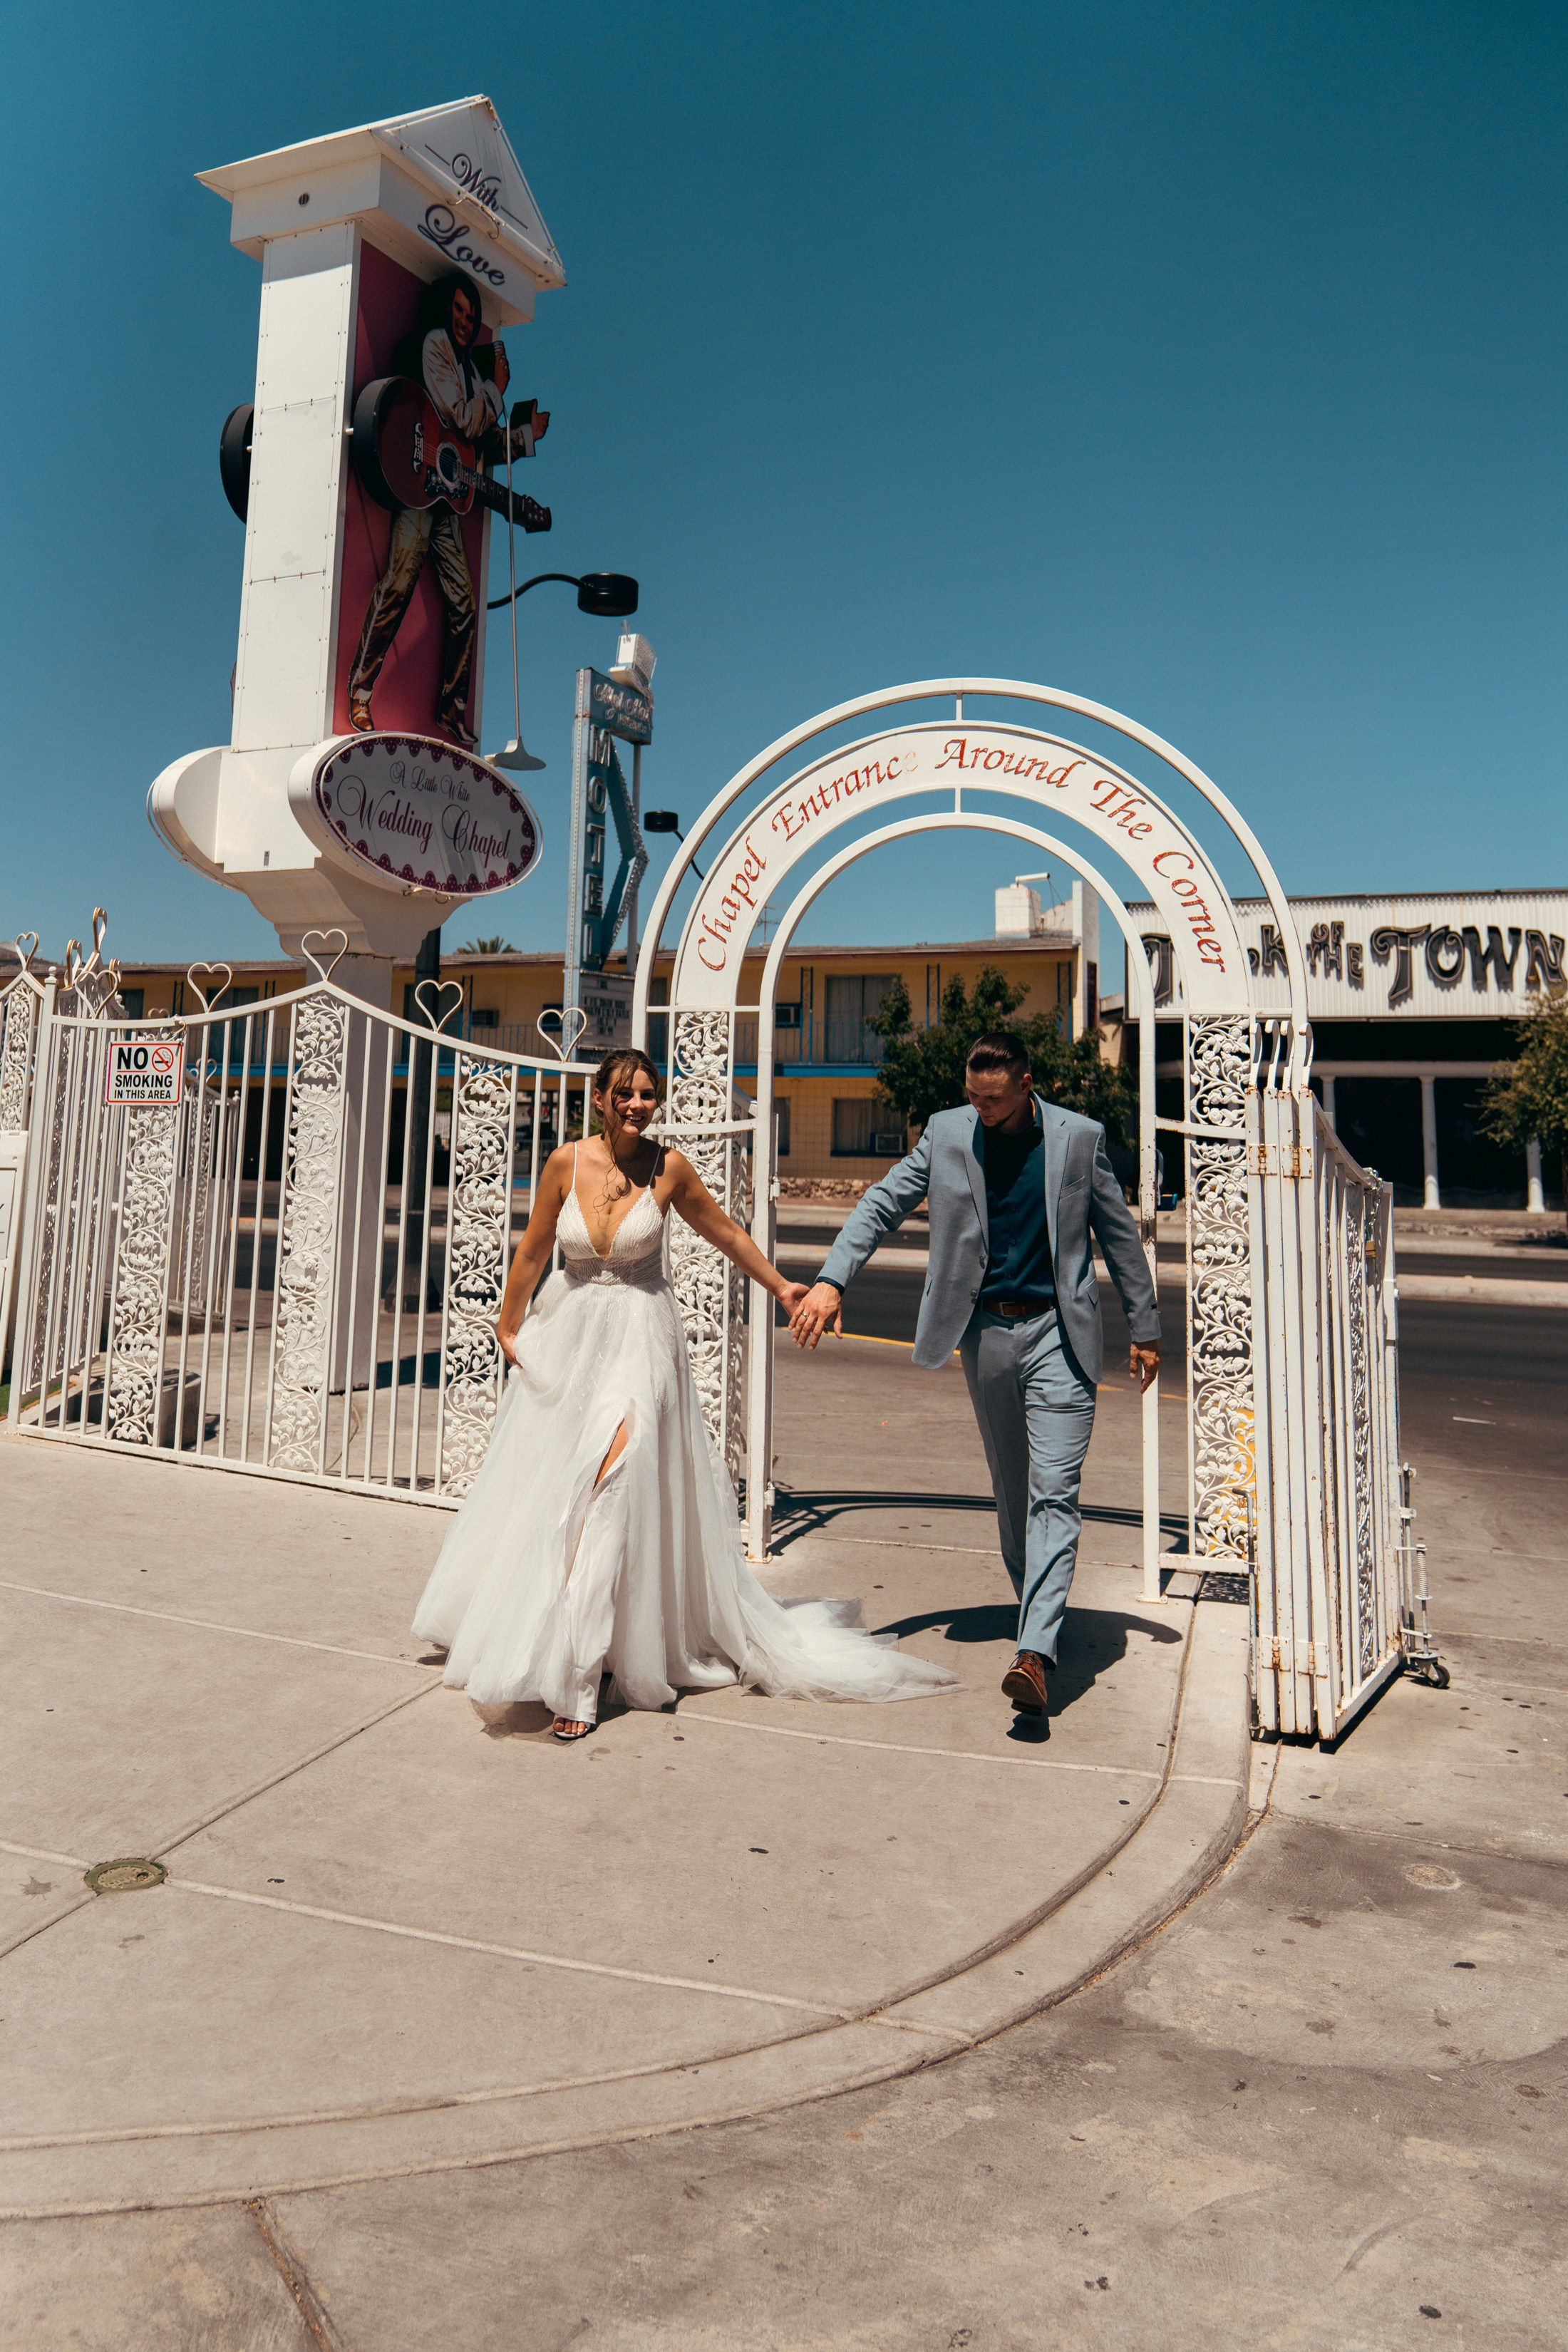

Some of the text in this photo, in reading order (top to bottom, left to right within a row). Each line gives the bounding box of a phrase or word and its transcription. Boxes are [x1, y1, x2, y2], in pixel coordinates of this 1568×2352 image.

[452, 153, 502, 212] With
[418, 204, 505, 286] Love
[390, 760, 470, 803] A Little White
[336, 775, 511, 869] Wedding Chapel
[583, 724, 611, 965] MOTEL
[697, 738, 1226, 973] Chapel Entrance Around The Corner
[1310, 921, 1345, 944] OF
[1306, 942, 1364, 982] THE
[1370, 923, 1567, 1000] TOWN
[115, 1075, 172, 1088] SMOKING
[117, 1047, 149, 1070] NO
[114, 1090, 171, 1100] IN THIS AREA
